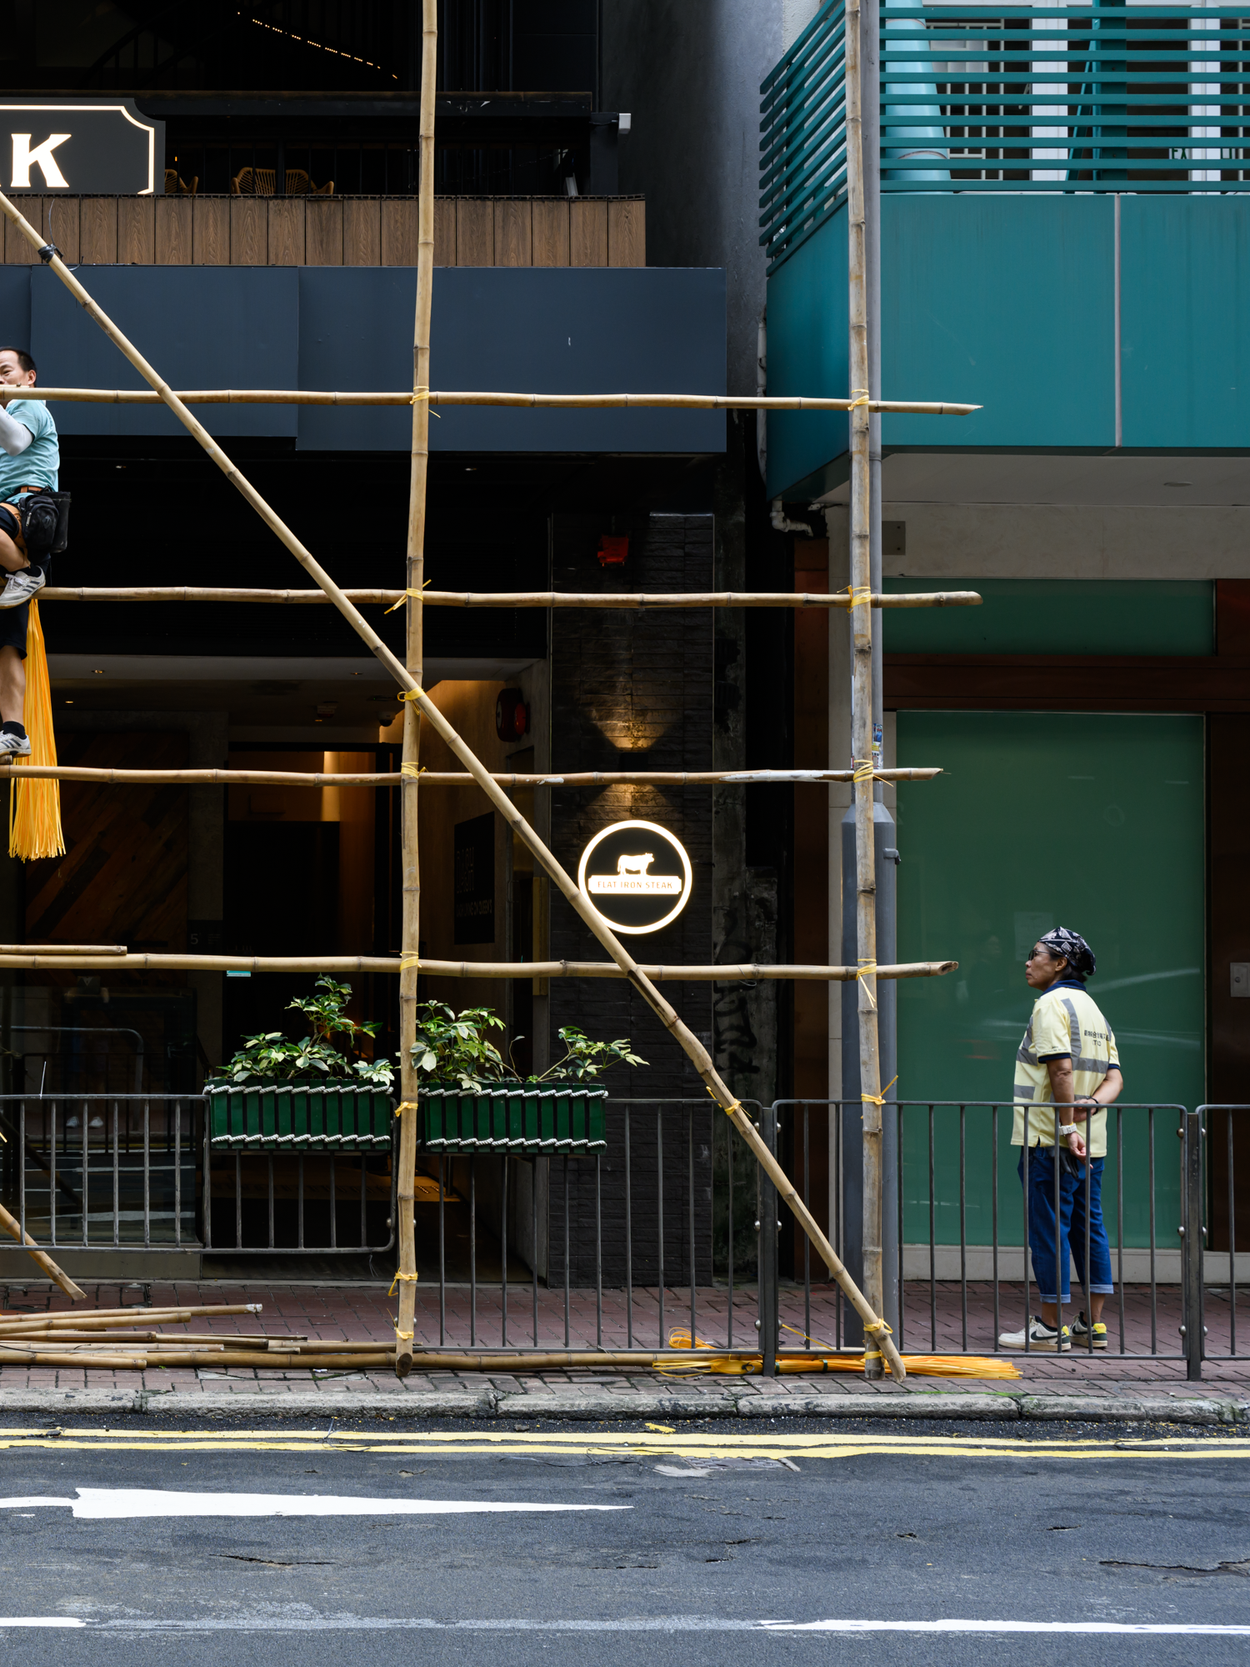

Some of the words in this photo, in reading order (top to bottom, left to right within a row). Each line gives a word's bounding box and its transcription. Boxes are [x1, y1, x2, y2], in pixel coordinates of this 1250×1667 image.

[597, 880, 617, 889] FLAT
[620, 880, 642, 889] IRON
[645, 881, 673, 890] STEAK
